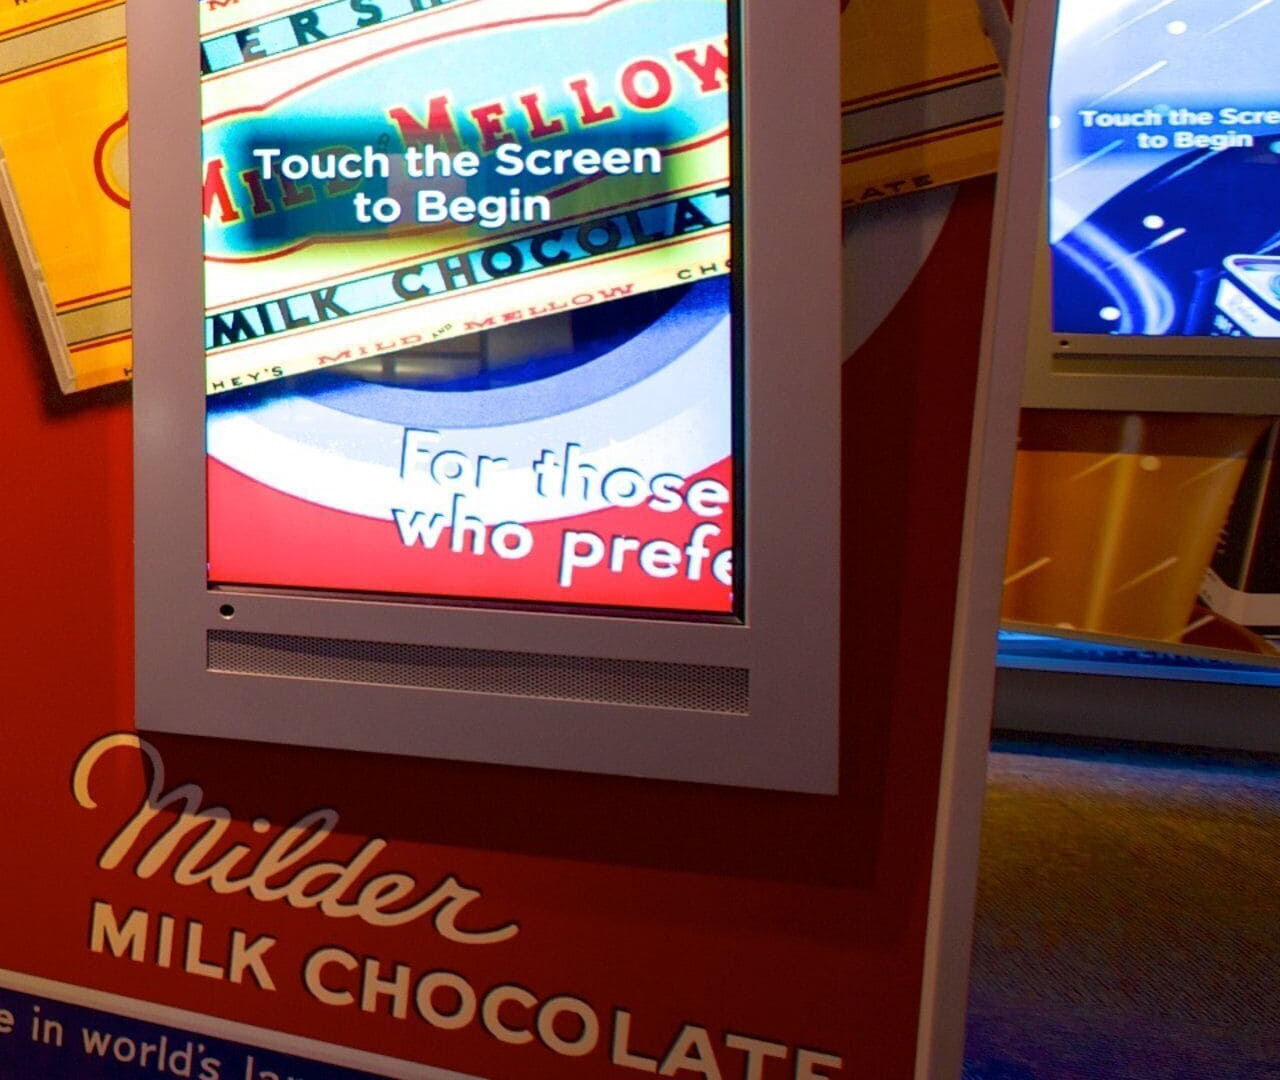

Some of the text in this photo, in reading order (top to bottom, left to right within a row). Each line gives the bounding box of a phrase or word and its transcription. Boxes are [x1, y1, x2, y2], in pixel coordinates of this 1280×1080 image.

[389, 35, 730, 153] MELLOW
[1079, 108, 1213, 128] Touch the
[252, 142, 663, 181] Touch the Screen
[1137, 131, 1253, 151] to Begin
[354, 187, 552, 230] to Begin
[211, 284, 351, 349] MILK
[462, 281, 637, 331] MELLOW
[316, 332, 425, 367] MILD
[399, 426, 730, 517] For those
[391, 493, 534, 561] who
[69, 731, 519, 947] Milder
[89, 901, 280, 991] MILK
[30, 1005, 65, 1048] in
